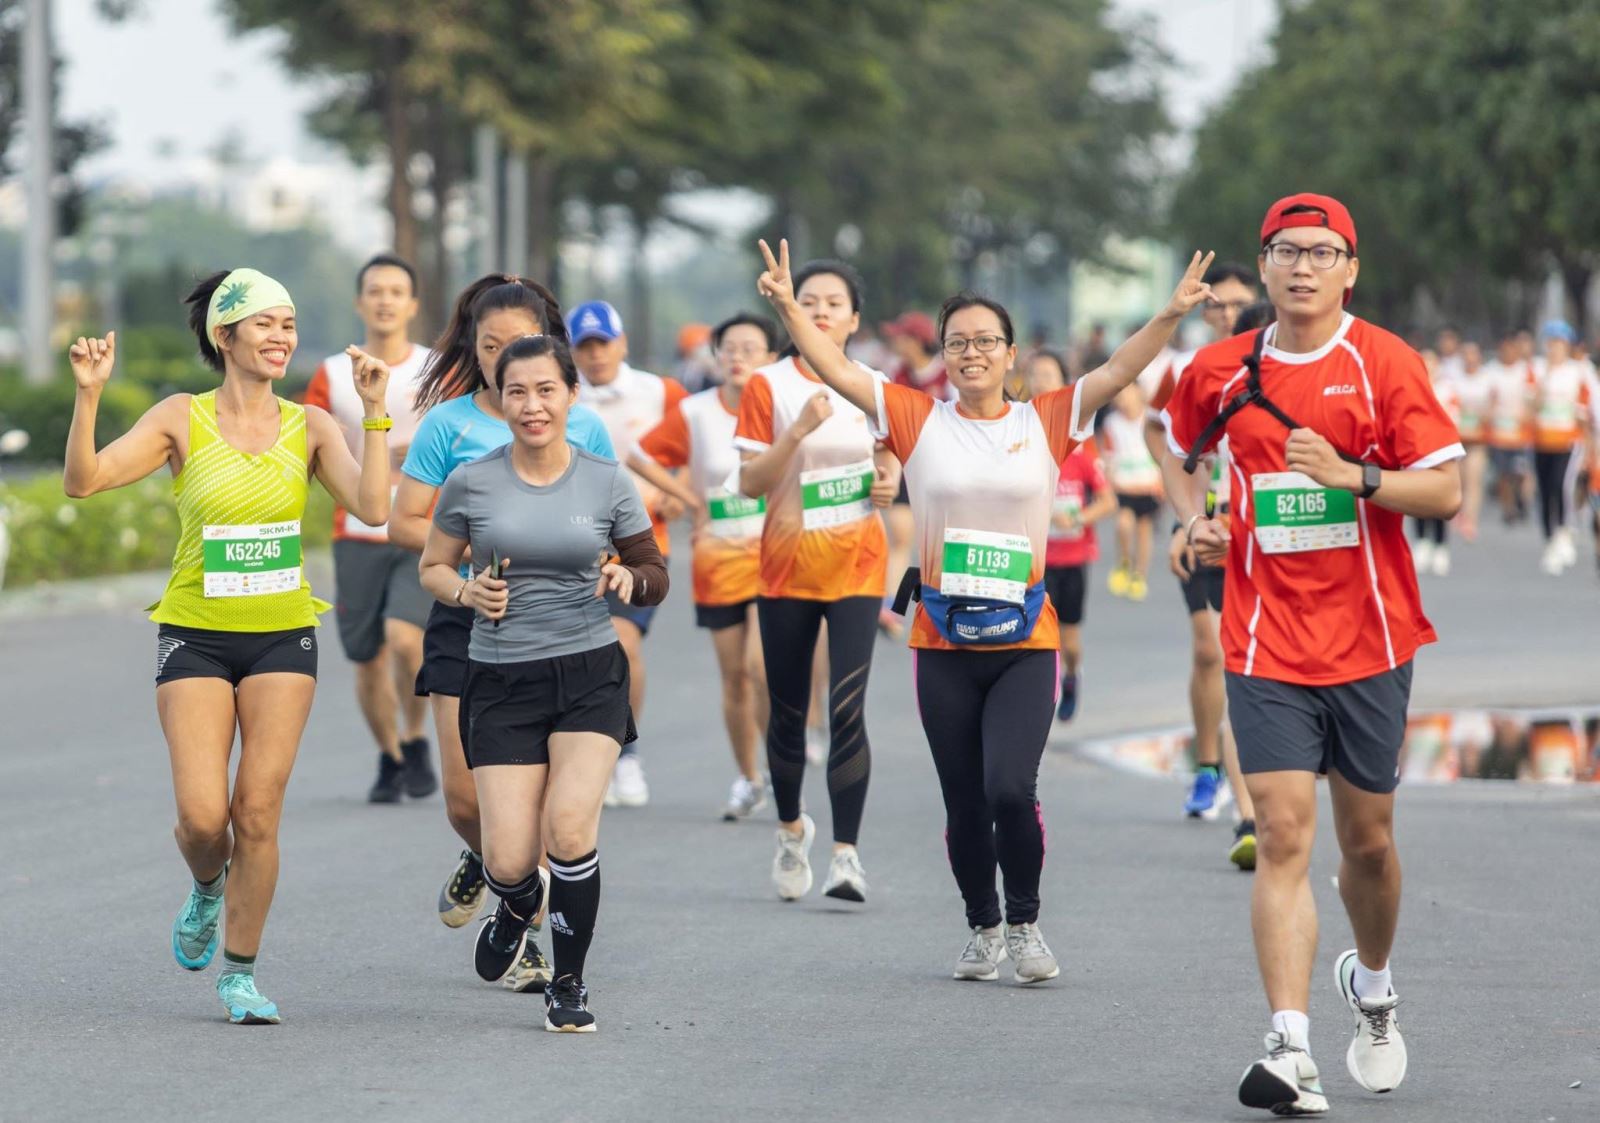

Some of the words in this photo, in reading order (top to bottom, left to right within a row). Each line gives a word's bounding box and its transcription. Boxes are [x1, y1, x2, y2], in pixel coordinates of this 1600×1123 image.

[1277, 492, 1327, 514] 52165
[225, 540, 281, 562] K52245
[967, 547, 1010, 569] 51133
